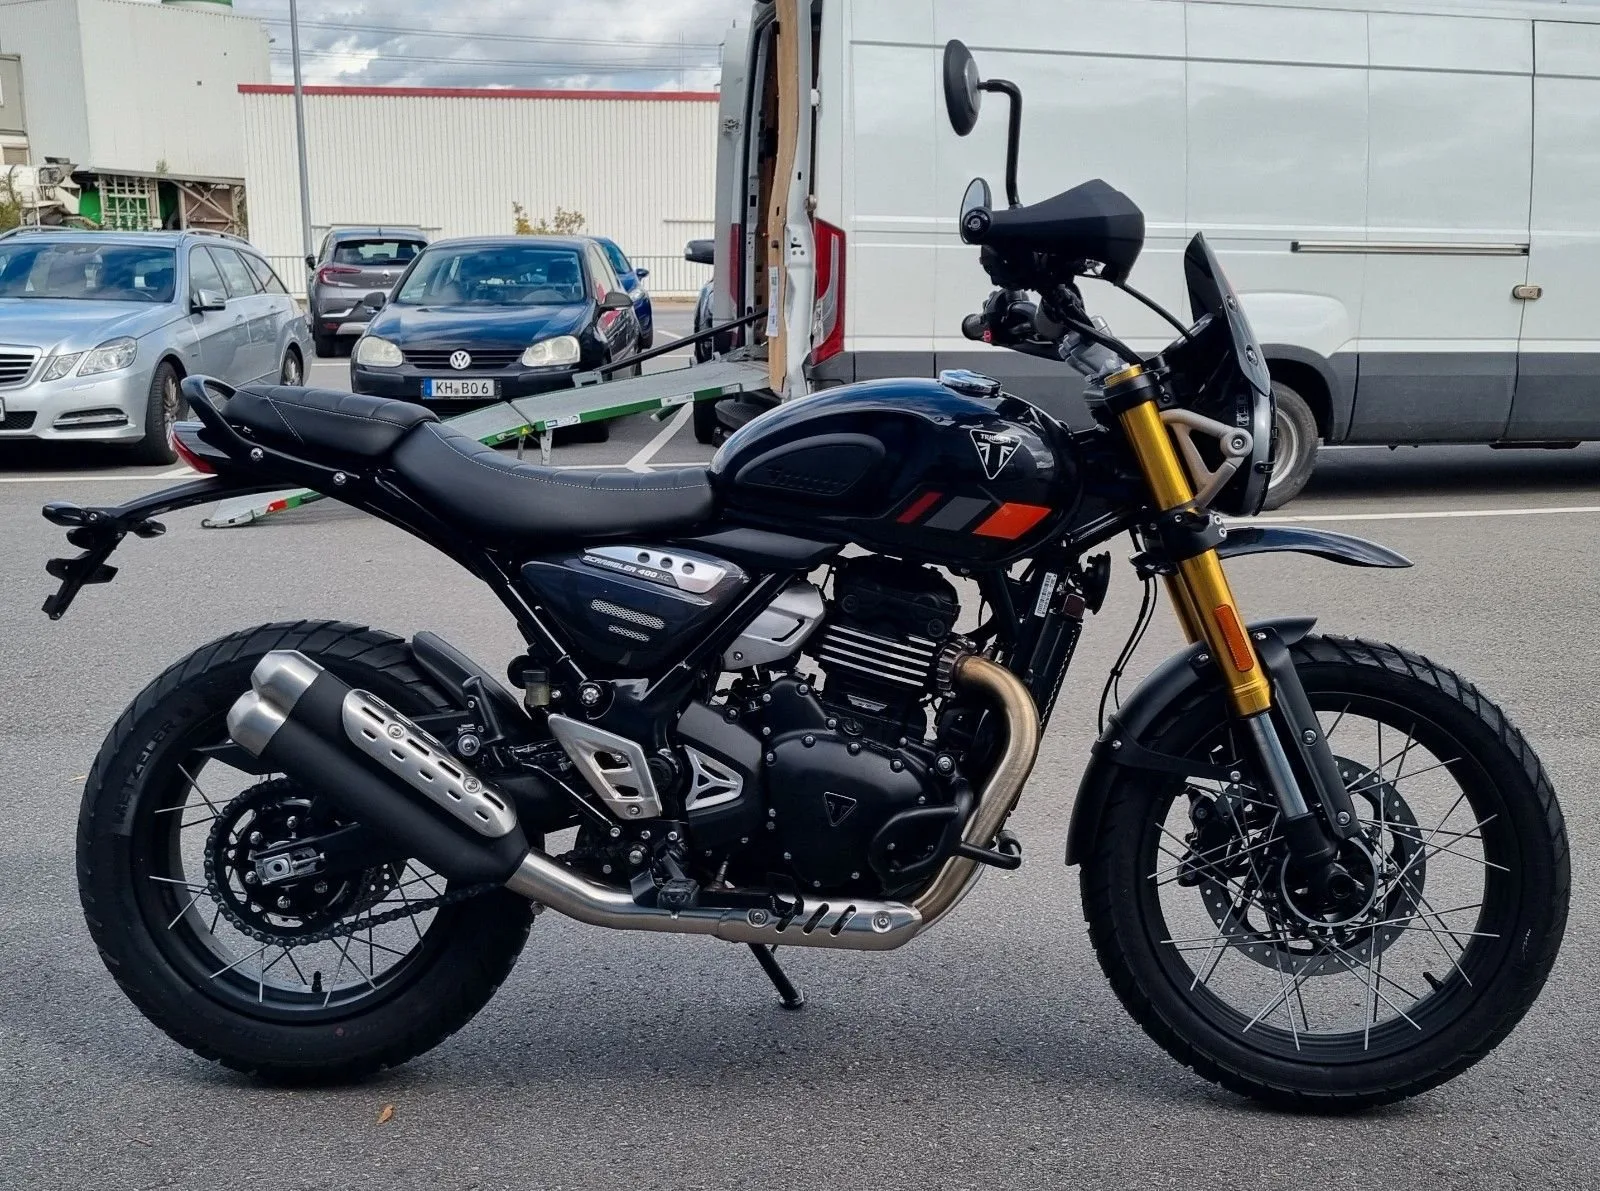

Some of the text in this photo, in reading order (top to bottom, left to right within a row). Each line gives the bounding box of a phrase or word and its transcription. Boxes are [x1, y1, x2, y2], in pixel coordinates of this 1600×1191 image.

[435, 381, 489, 394] KH BO 6
[980, 433, 1012, 443] TRIU
[583, 555, 671, 582] SCRAMBLER 400 XC
